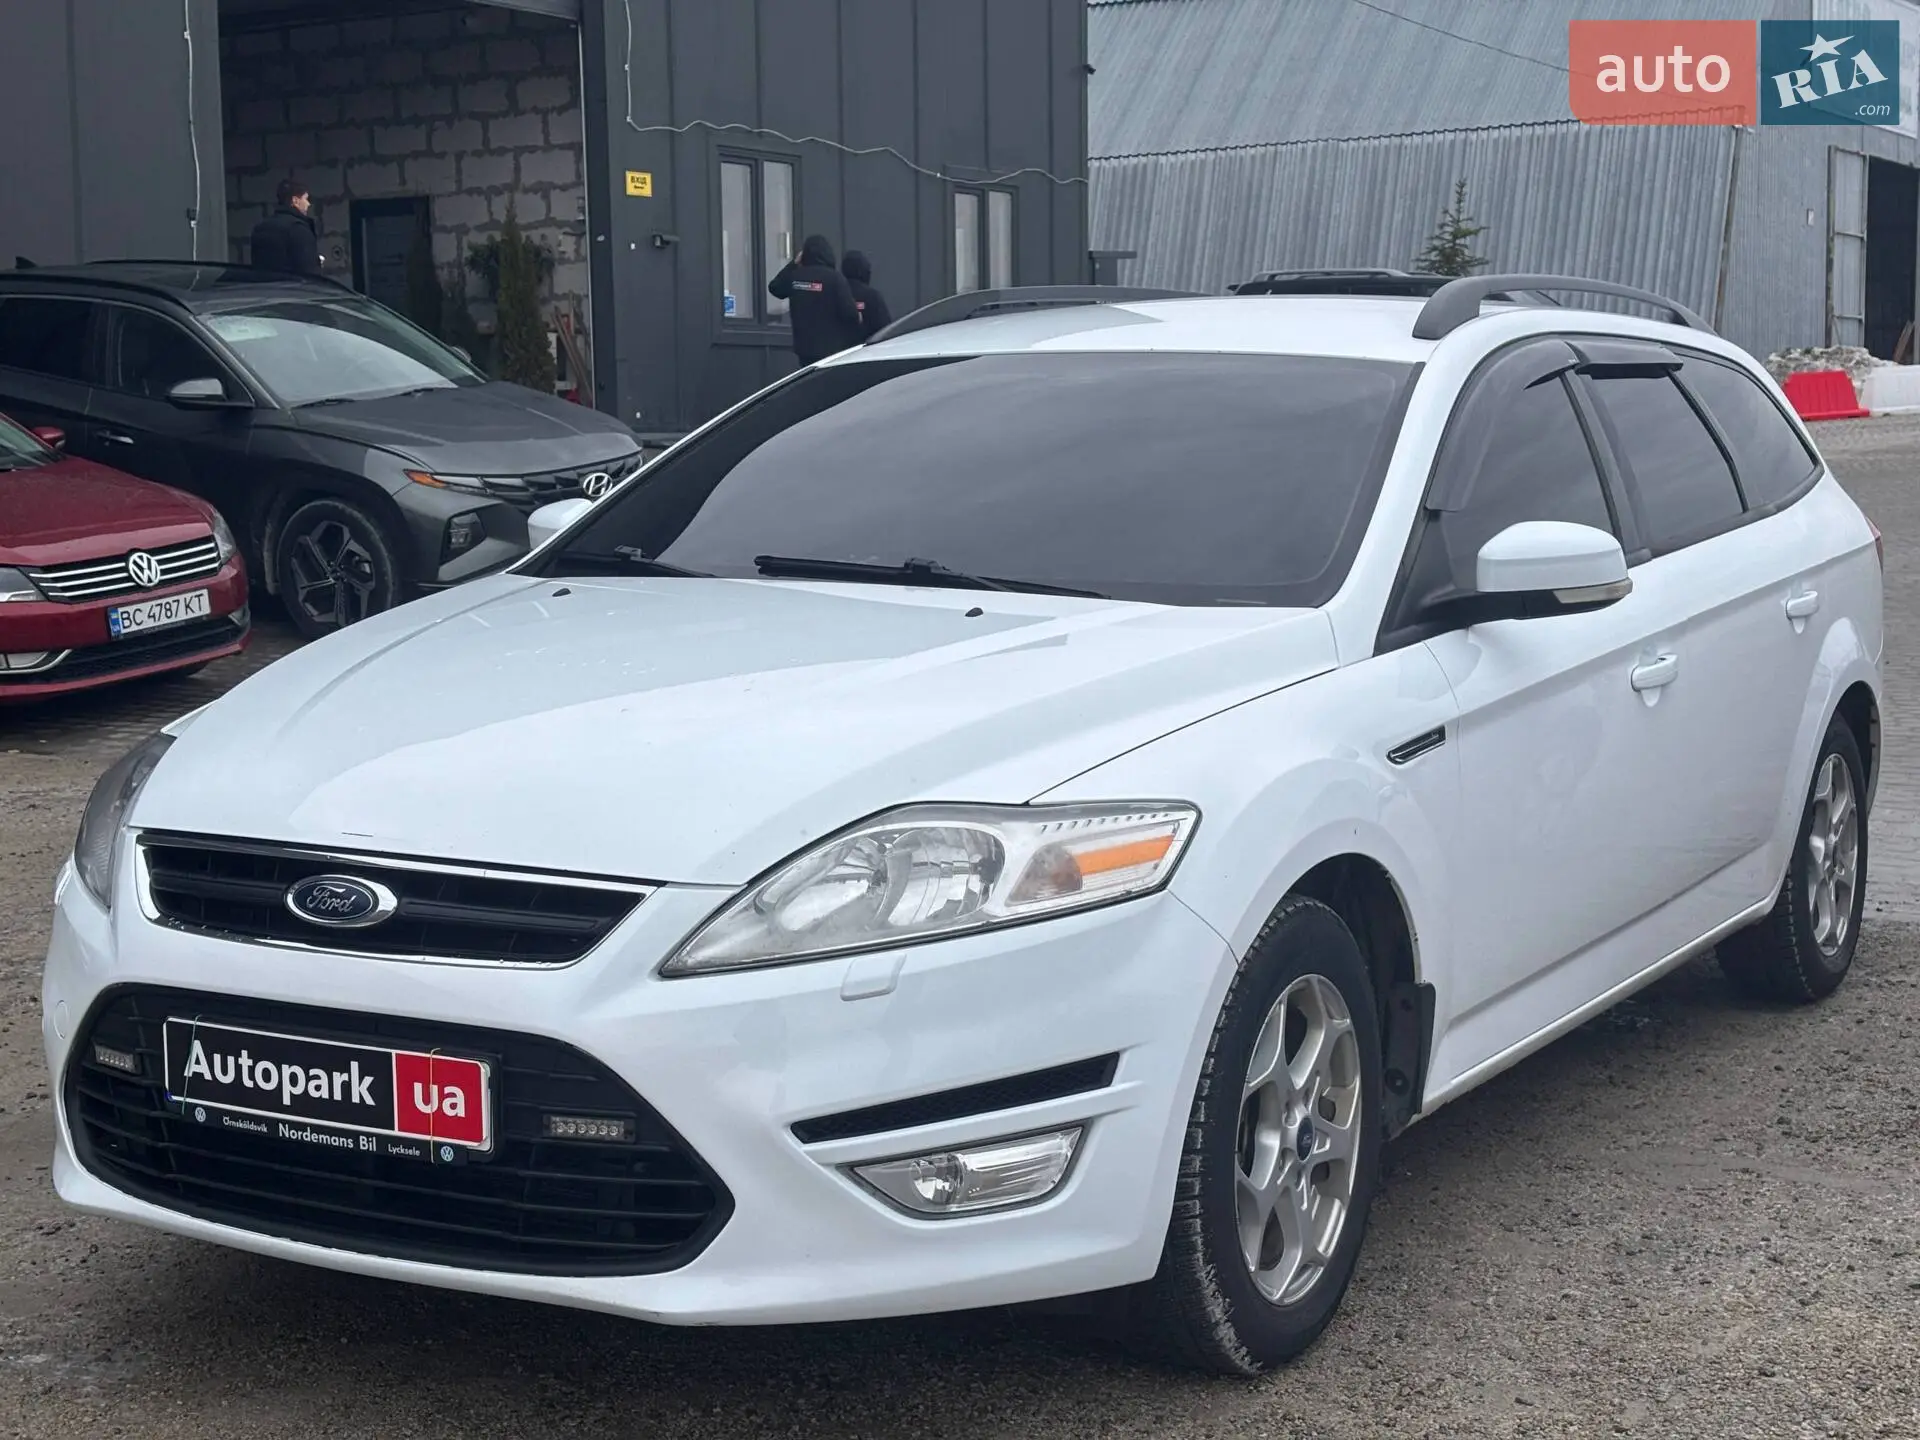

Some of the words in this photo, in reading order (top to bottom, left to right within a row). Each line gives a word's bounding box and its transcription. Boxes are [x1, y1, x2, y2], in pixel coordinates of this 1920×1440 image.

[120, 607, 144, 630] BC
[147, 599, 181, 623] 4787
[184, 593, 204, 616] KT
[306, 884, 357, 913] Ford
[184, 1039, 377, 1107] Autopark
[413, 1081, 467, 1118] ua
[279, 1123, 354, 1150] Nordemans
[359, 1135, 378, 1152] Bil
[388, 1143, 421, 1157] Lycksele
